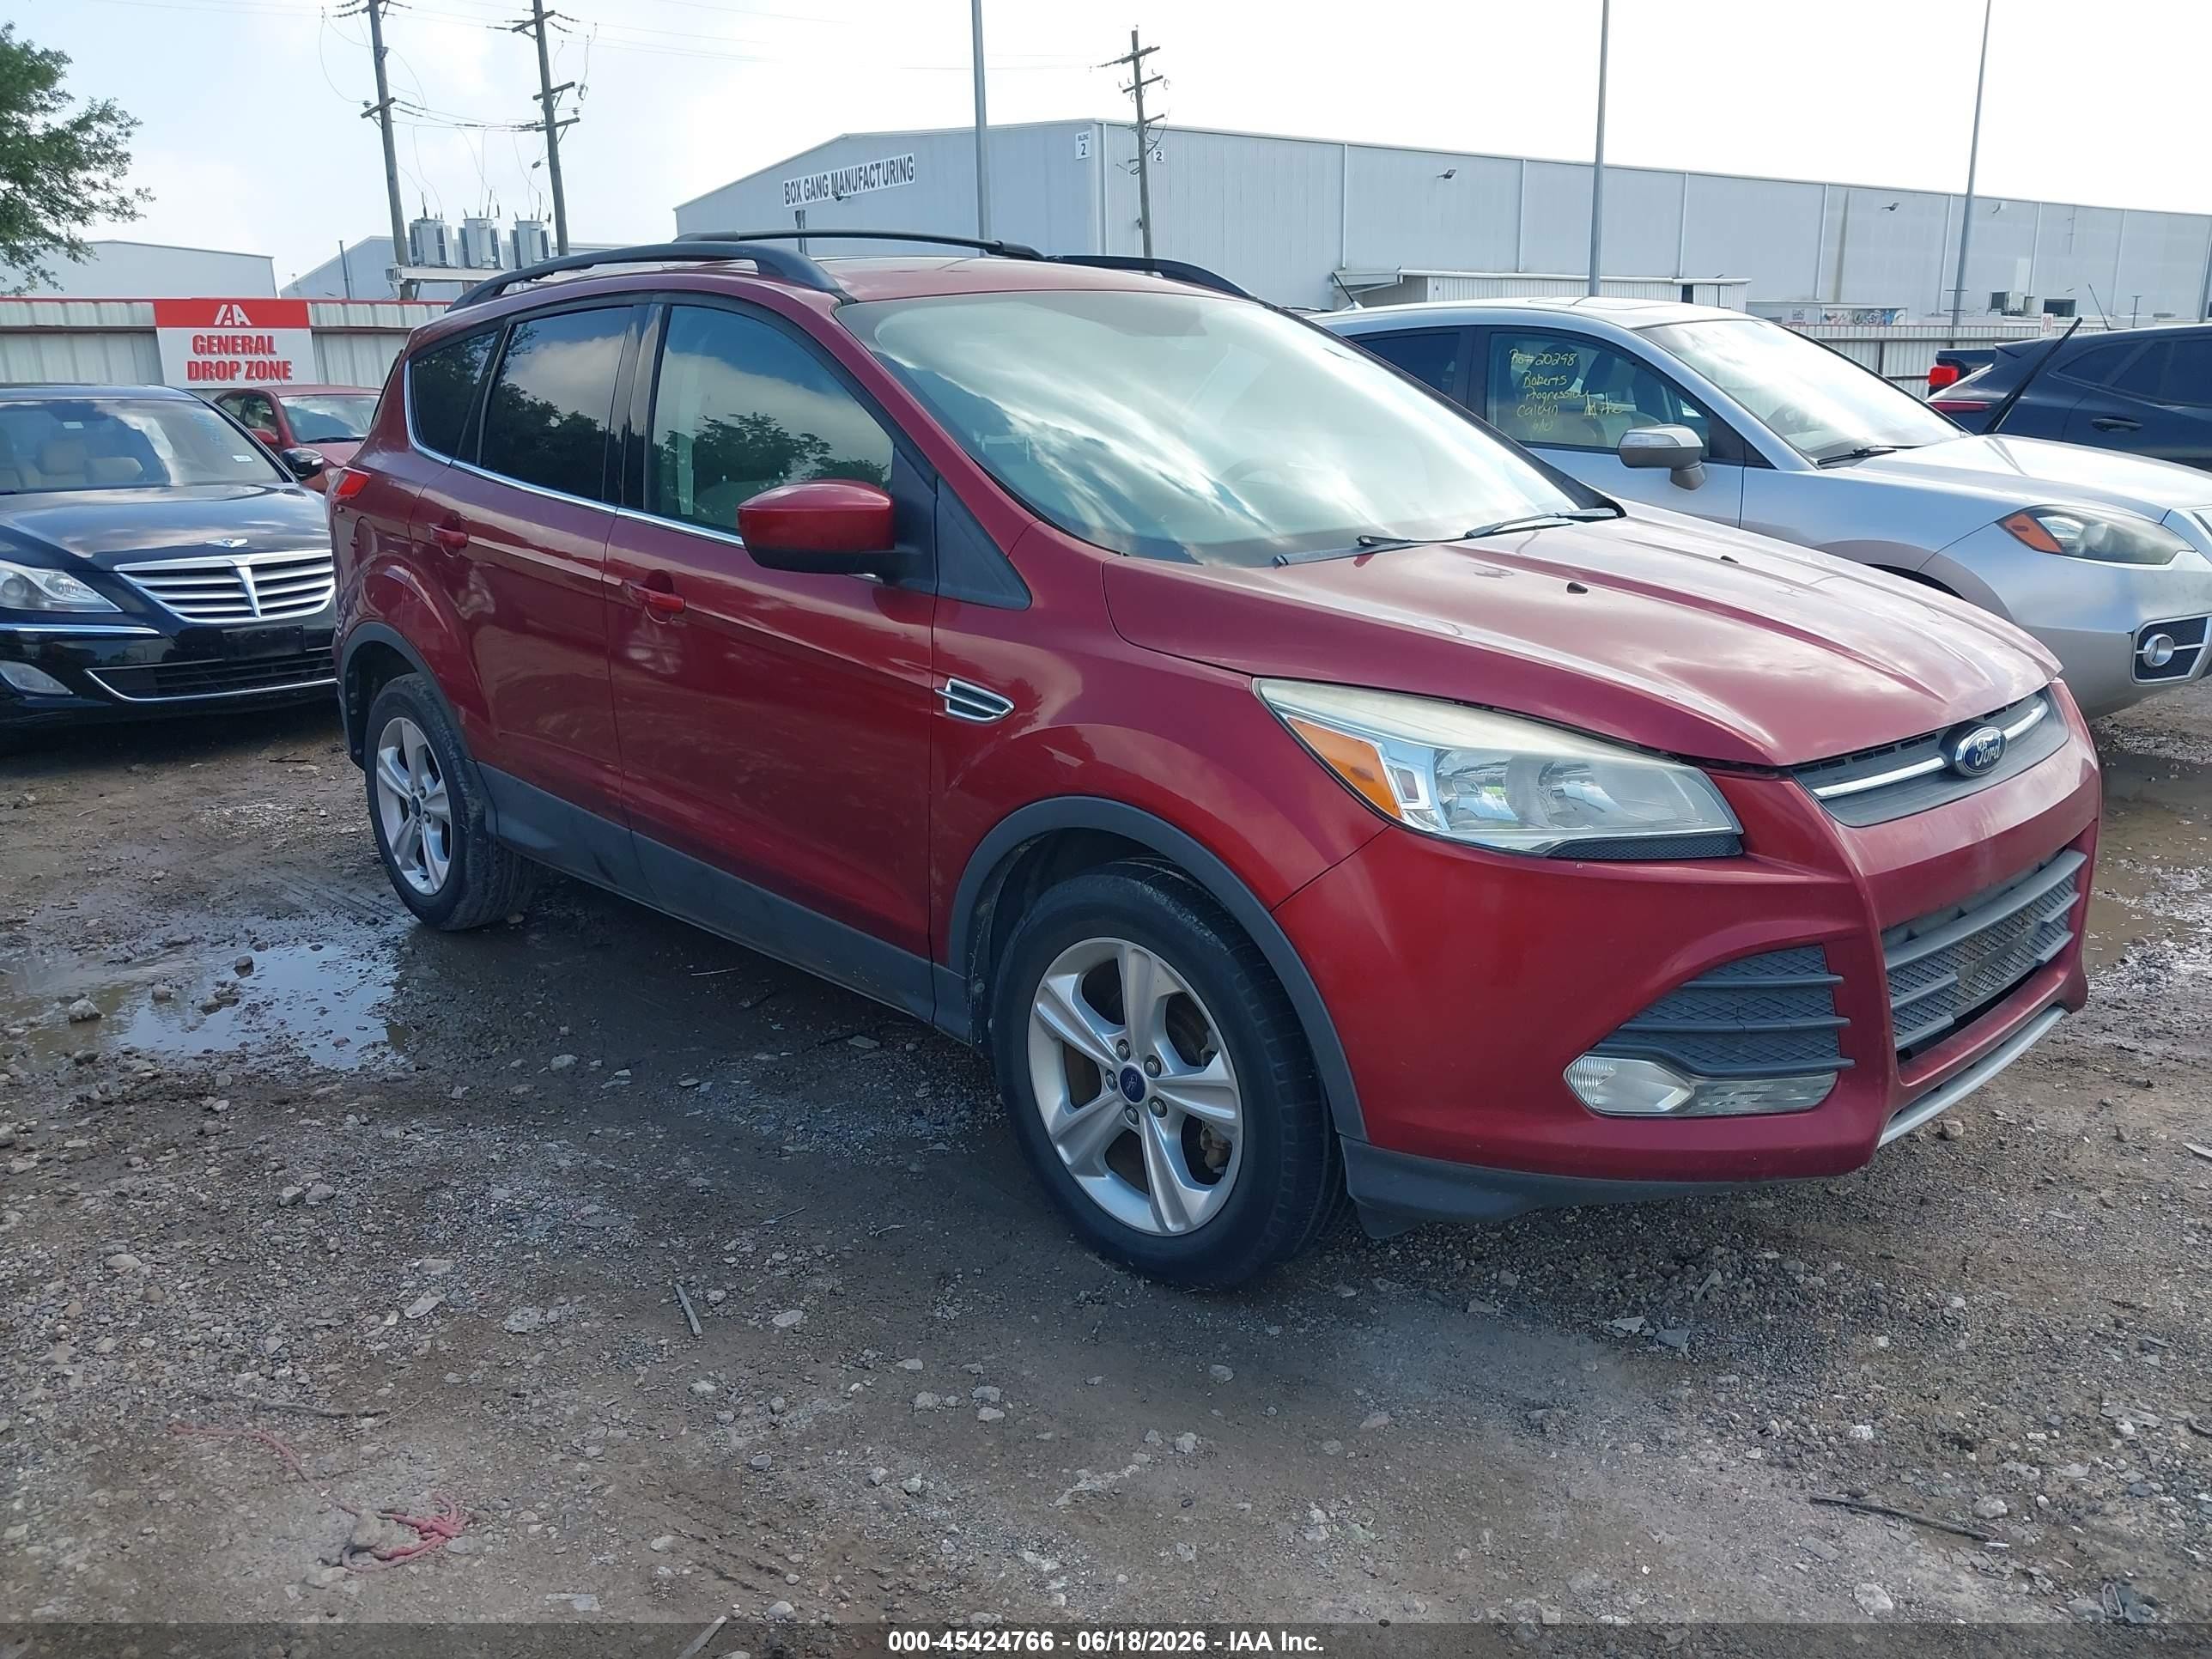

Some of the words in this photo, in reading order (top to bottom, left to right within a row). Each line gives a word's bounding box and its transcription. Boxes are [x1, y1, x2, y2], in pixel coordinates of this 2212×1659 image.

[1080, 143, 1086, 155] 2
[1156, 151, 1163, 161] 2
[784, 181, 802, 205] BOX
[804, 173, 829, 201] GANG
[831, 155, 915, 196] MANUFACTURING
[2041, 316, 2052, 333] 20
[191, 334, 276, 356] GENERAL
[186, 361, 241, 381] DROP
[245, 360, 292, 380] ZONE
[1975, 735, 2002, 767] Ford
